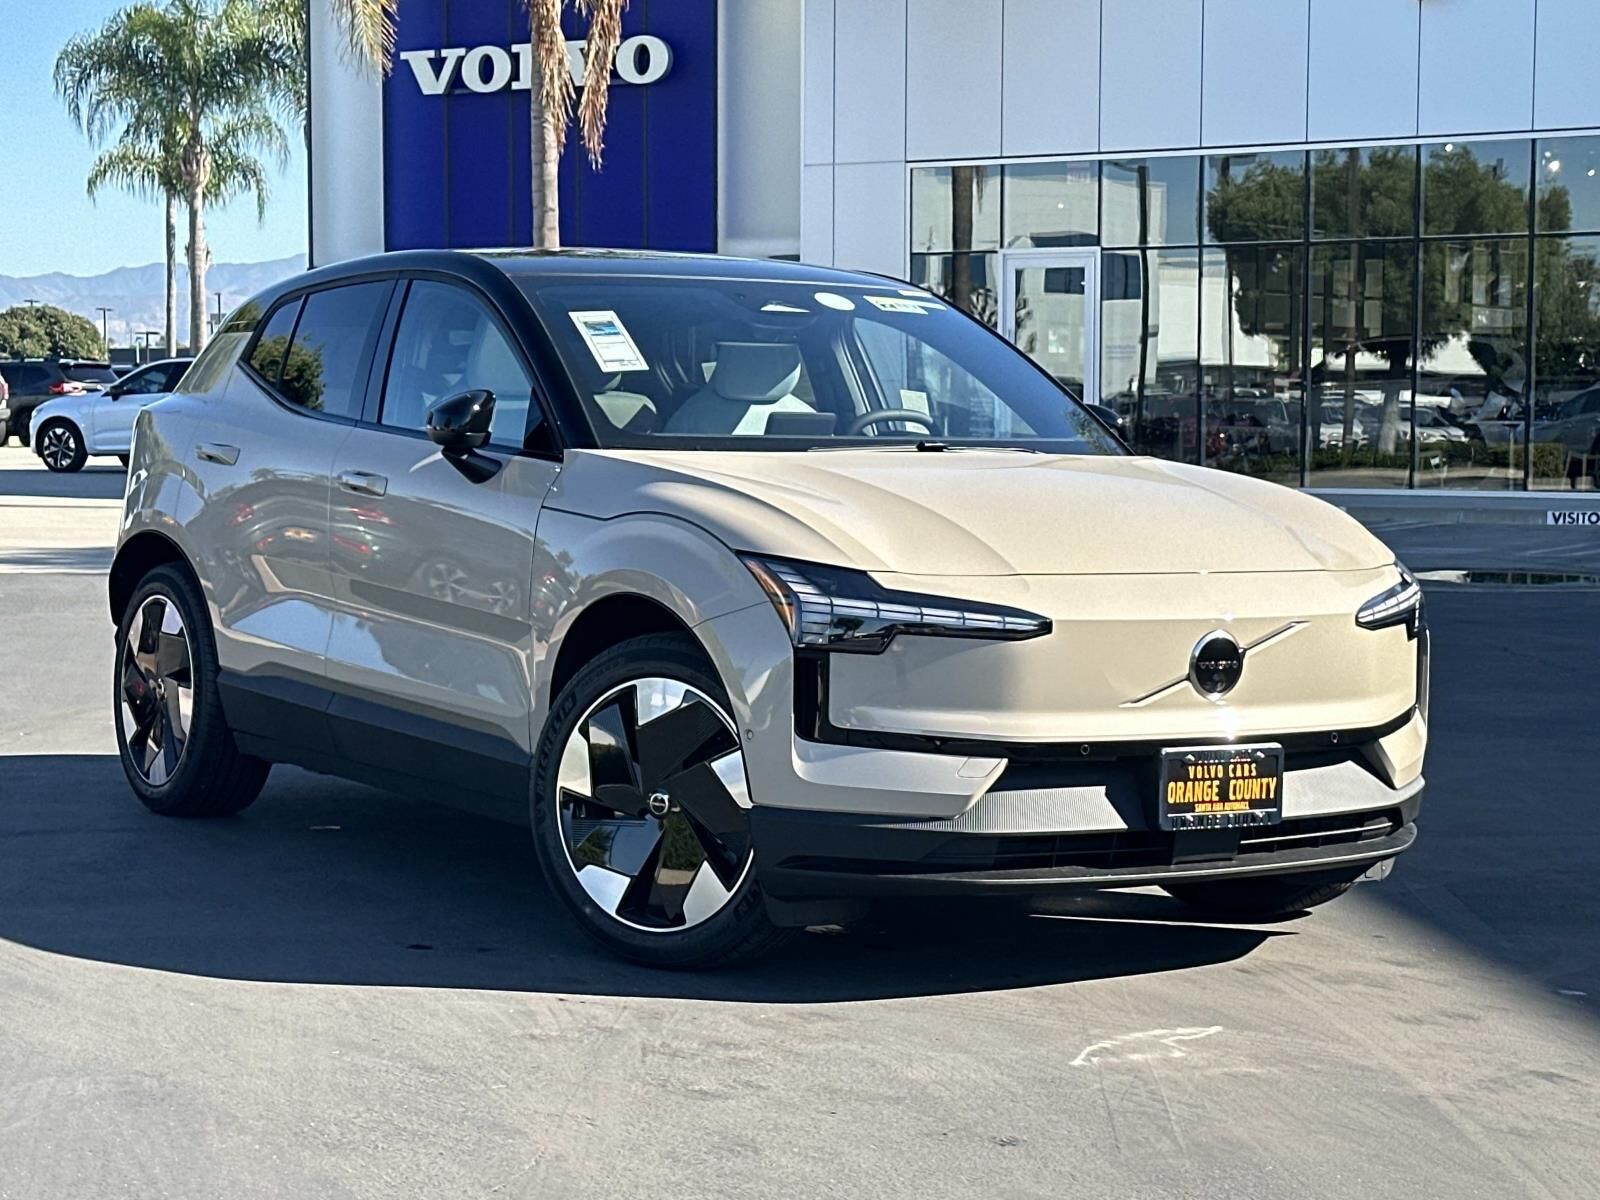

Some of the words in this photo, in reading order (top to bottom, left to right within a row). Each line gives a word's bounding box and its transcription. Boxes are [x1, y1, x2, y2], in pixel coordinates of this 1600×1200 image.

[1552, 511, 1600, 525] VISITO
[1188, 764, 1223, 779] VOLVO
[1228, 763, 1256, 778] CARS
[1167, 780, 1220, 804] ORANGE
[1229, 777, 1277, 801] COUNTY
